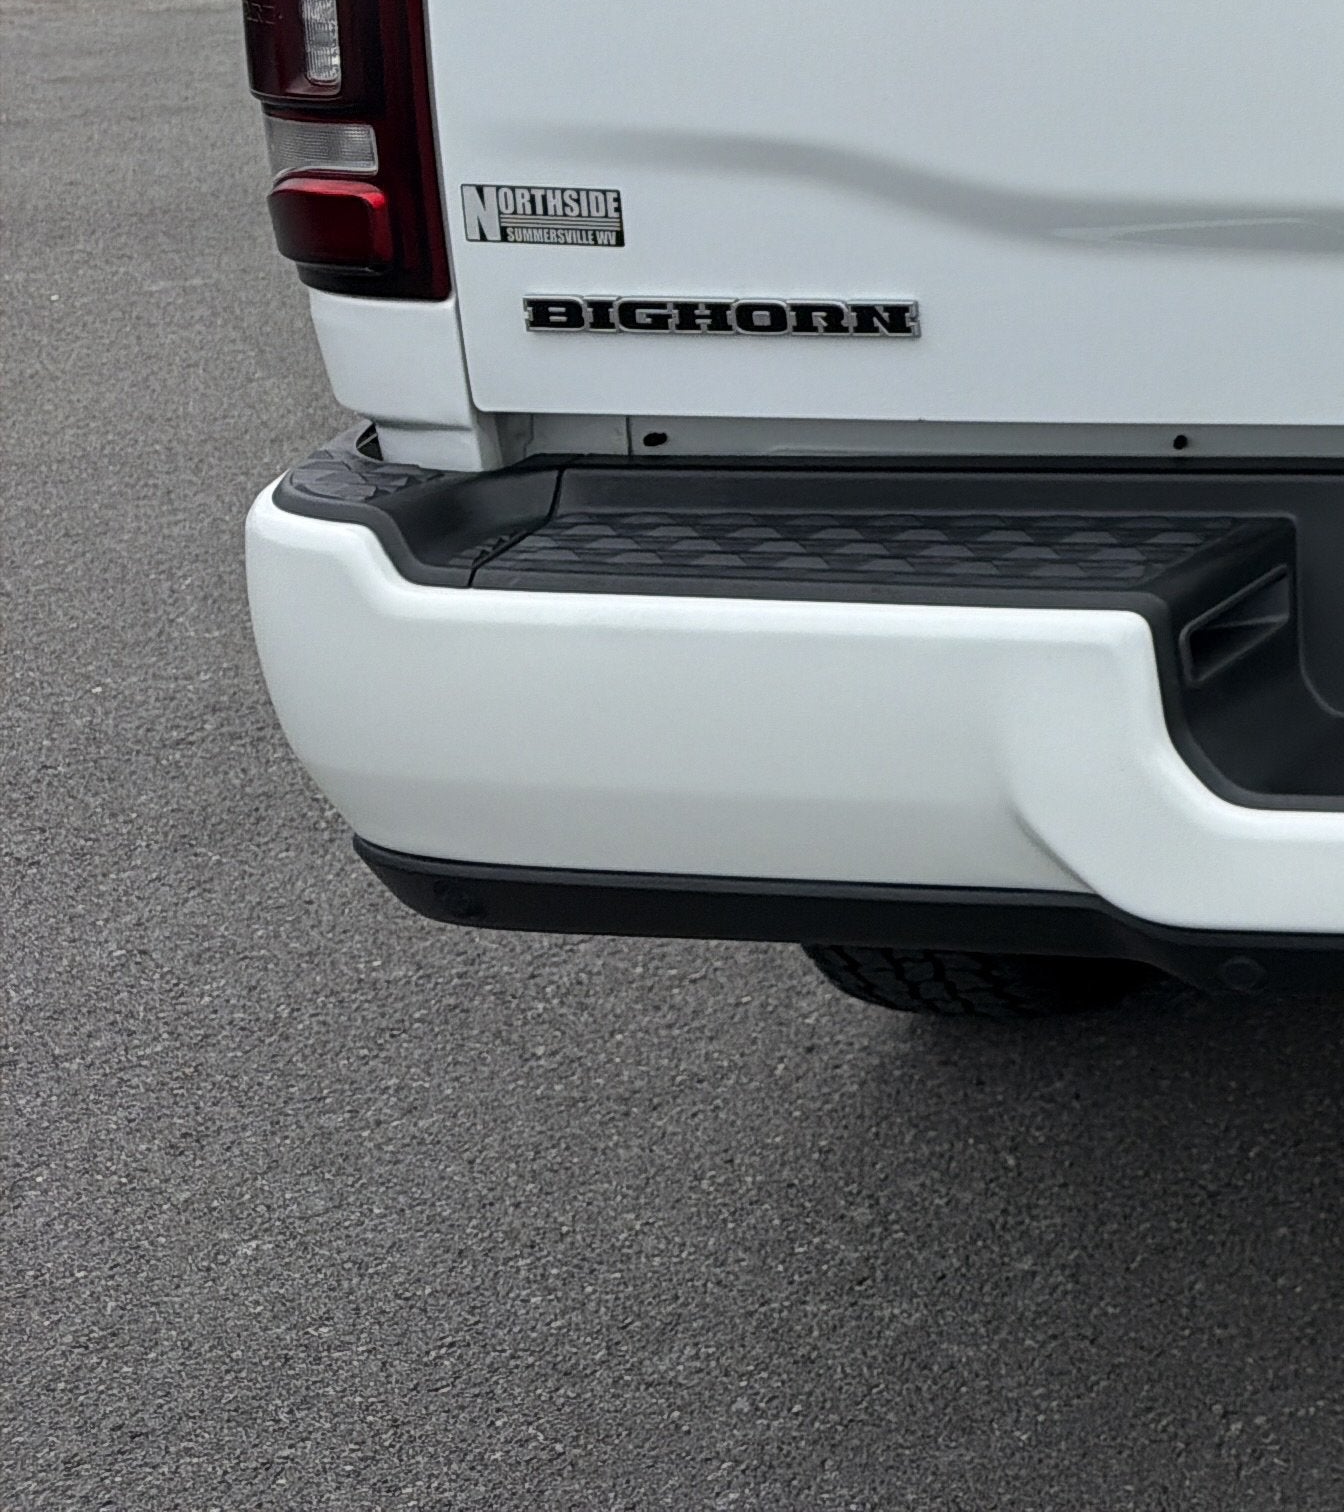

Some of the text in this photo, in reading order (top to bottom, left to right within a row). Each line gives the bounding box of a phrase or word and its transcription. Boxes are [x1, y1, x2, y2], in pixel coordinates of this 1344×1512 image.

[461, 185, 621, 241] NORTHSIDE
[506, 227, 617, 246] SUMMERSVILLE WV
[522, 294, 921, 338] BIGHORN
